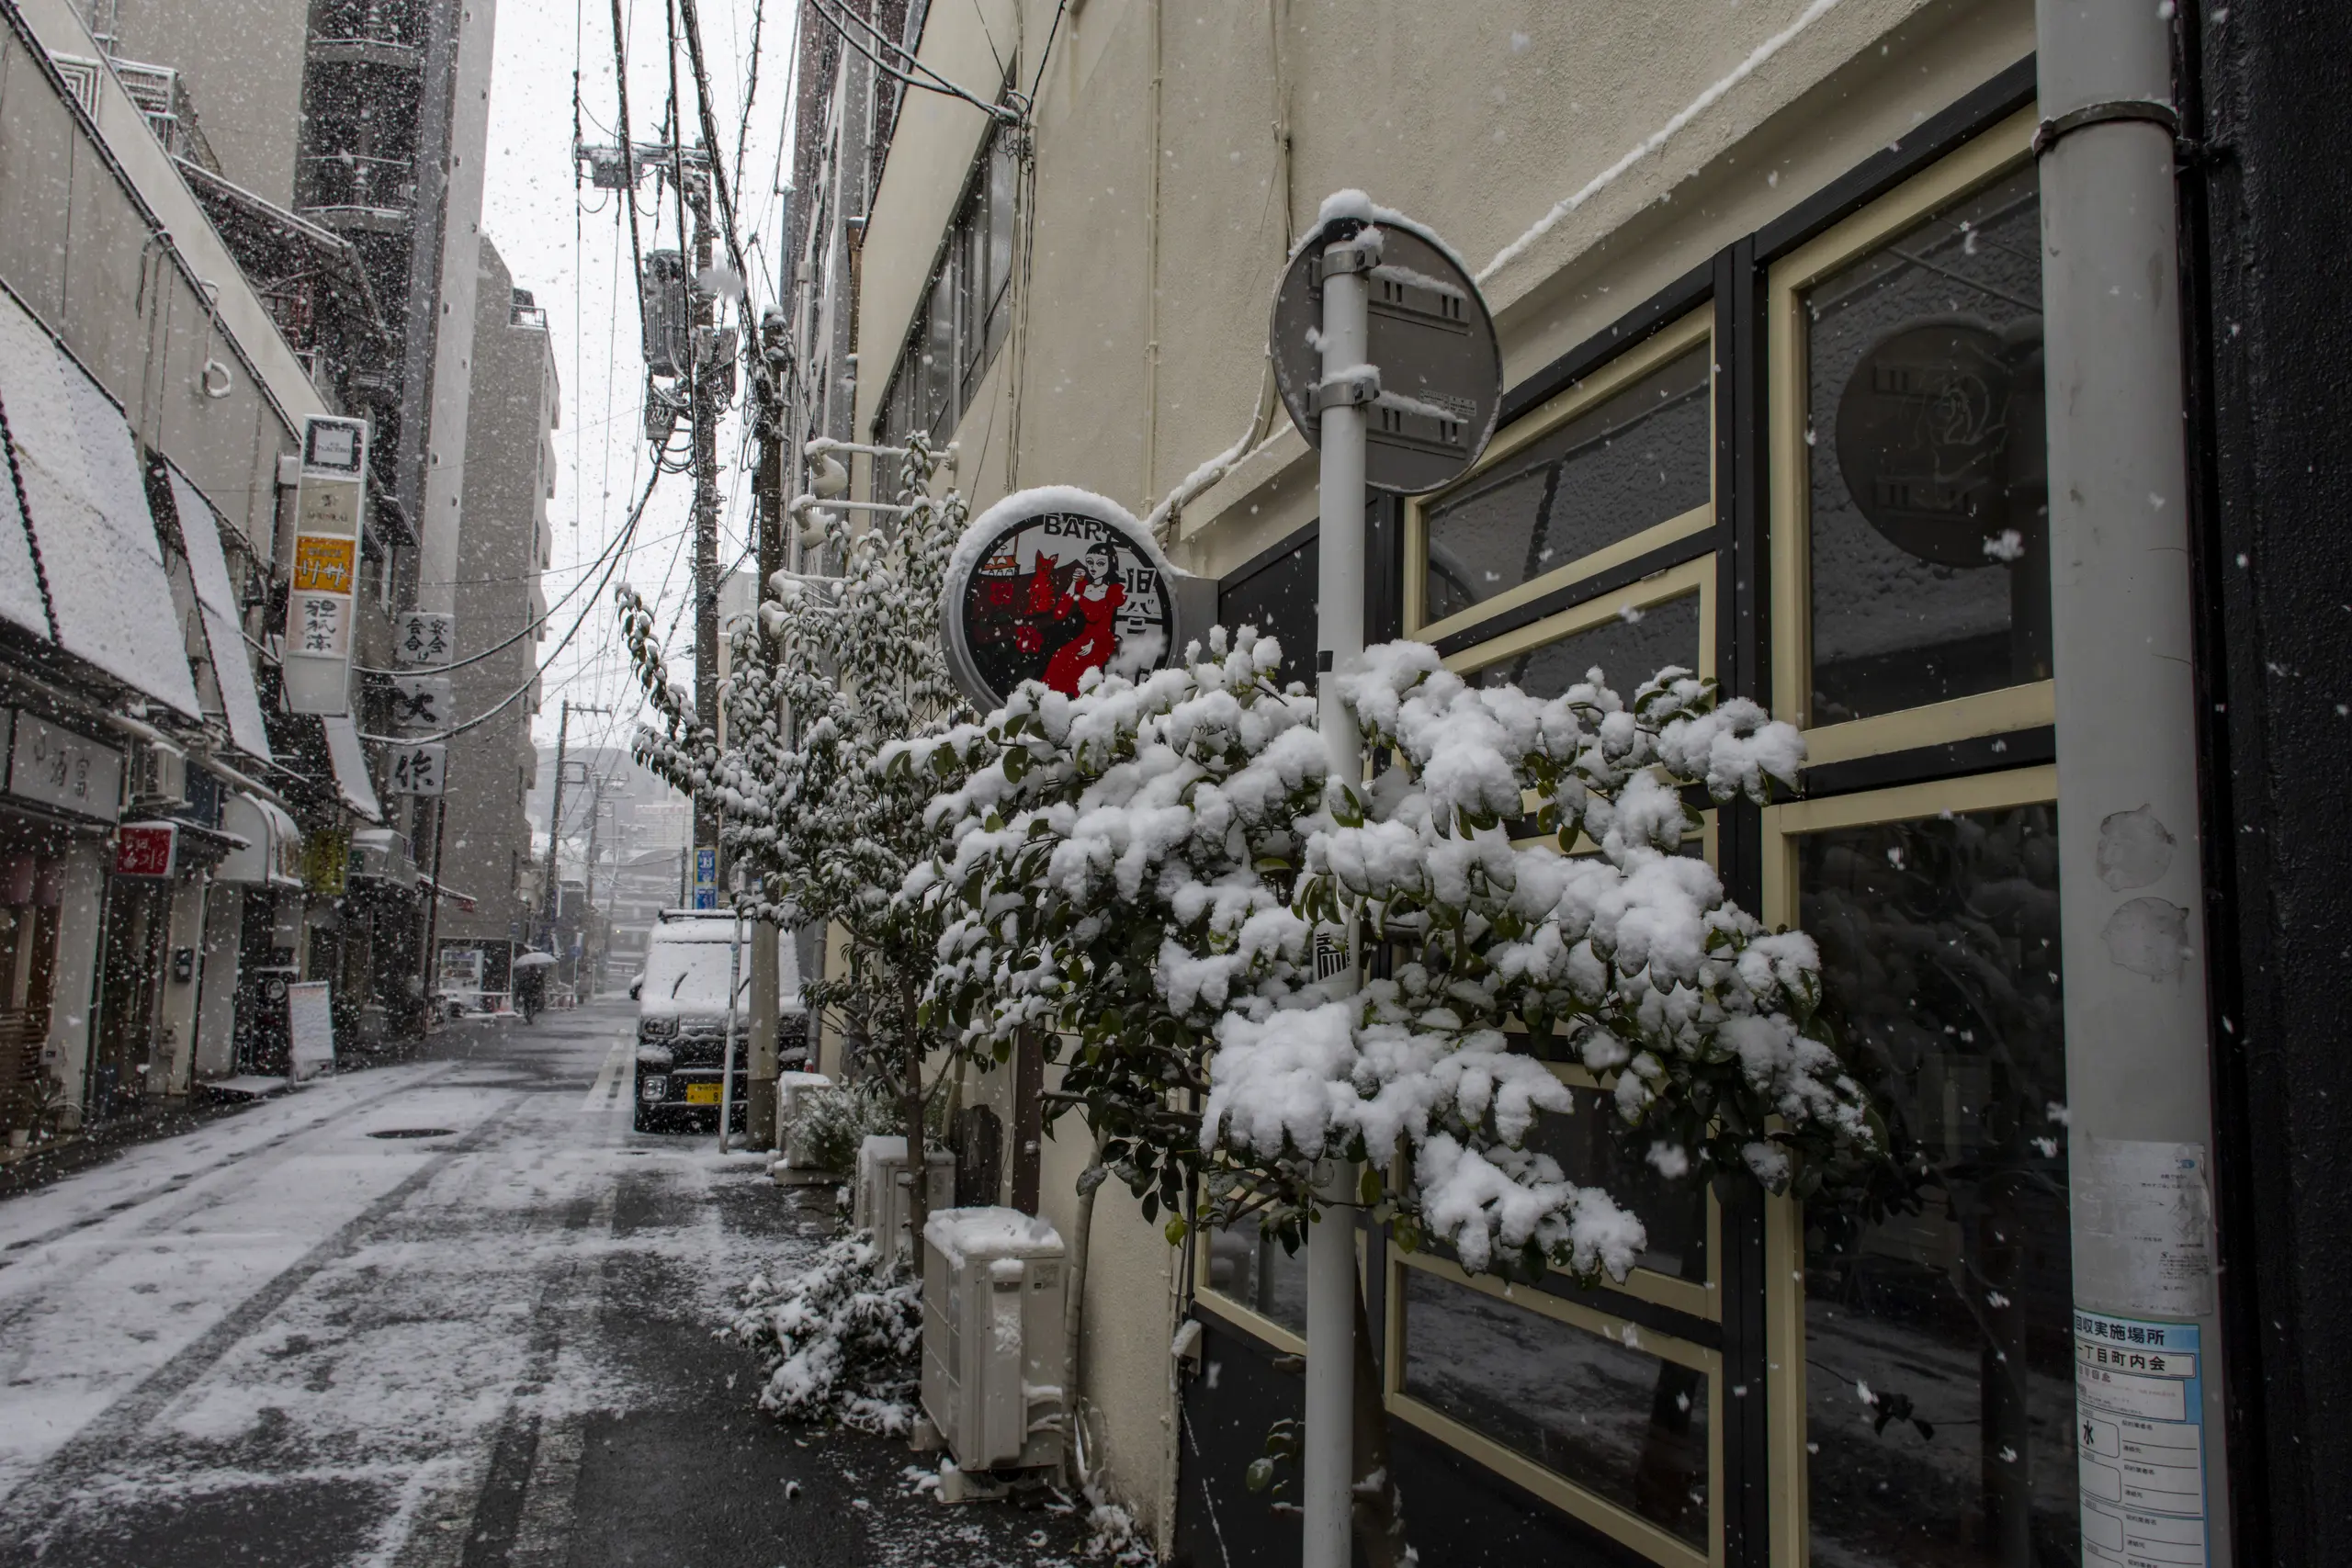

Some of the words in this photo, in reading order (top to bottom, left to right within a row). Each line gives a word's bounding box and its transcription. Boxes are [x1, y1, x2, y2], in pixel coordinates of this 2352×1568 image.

[1044, 514, 1103, 542] BAR
[2075, 1314, 2165, 1347] 回収実施場所
[2083, 1419, 2095, 1445] 水
